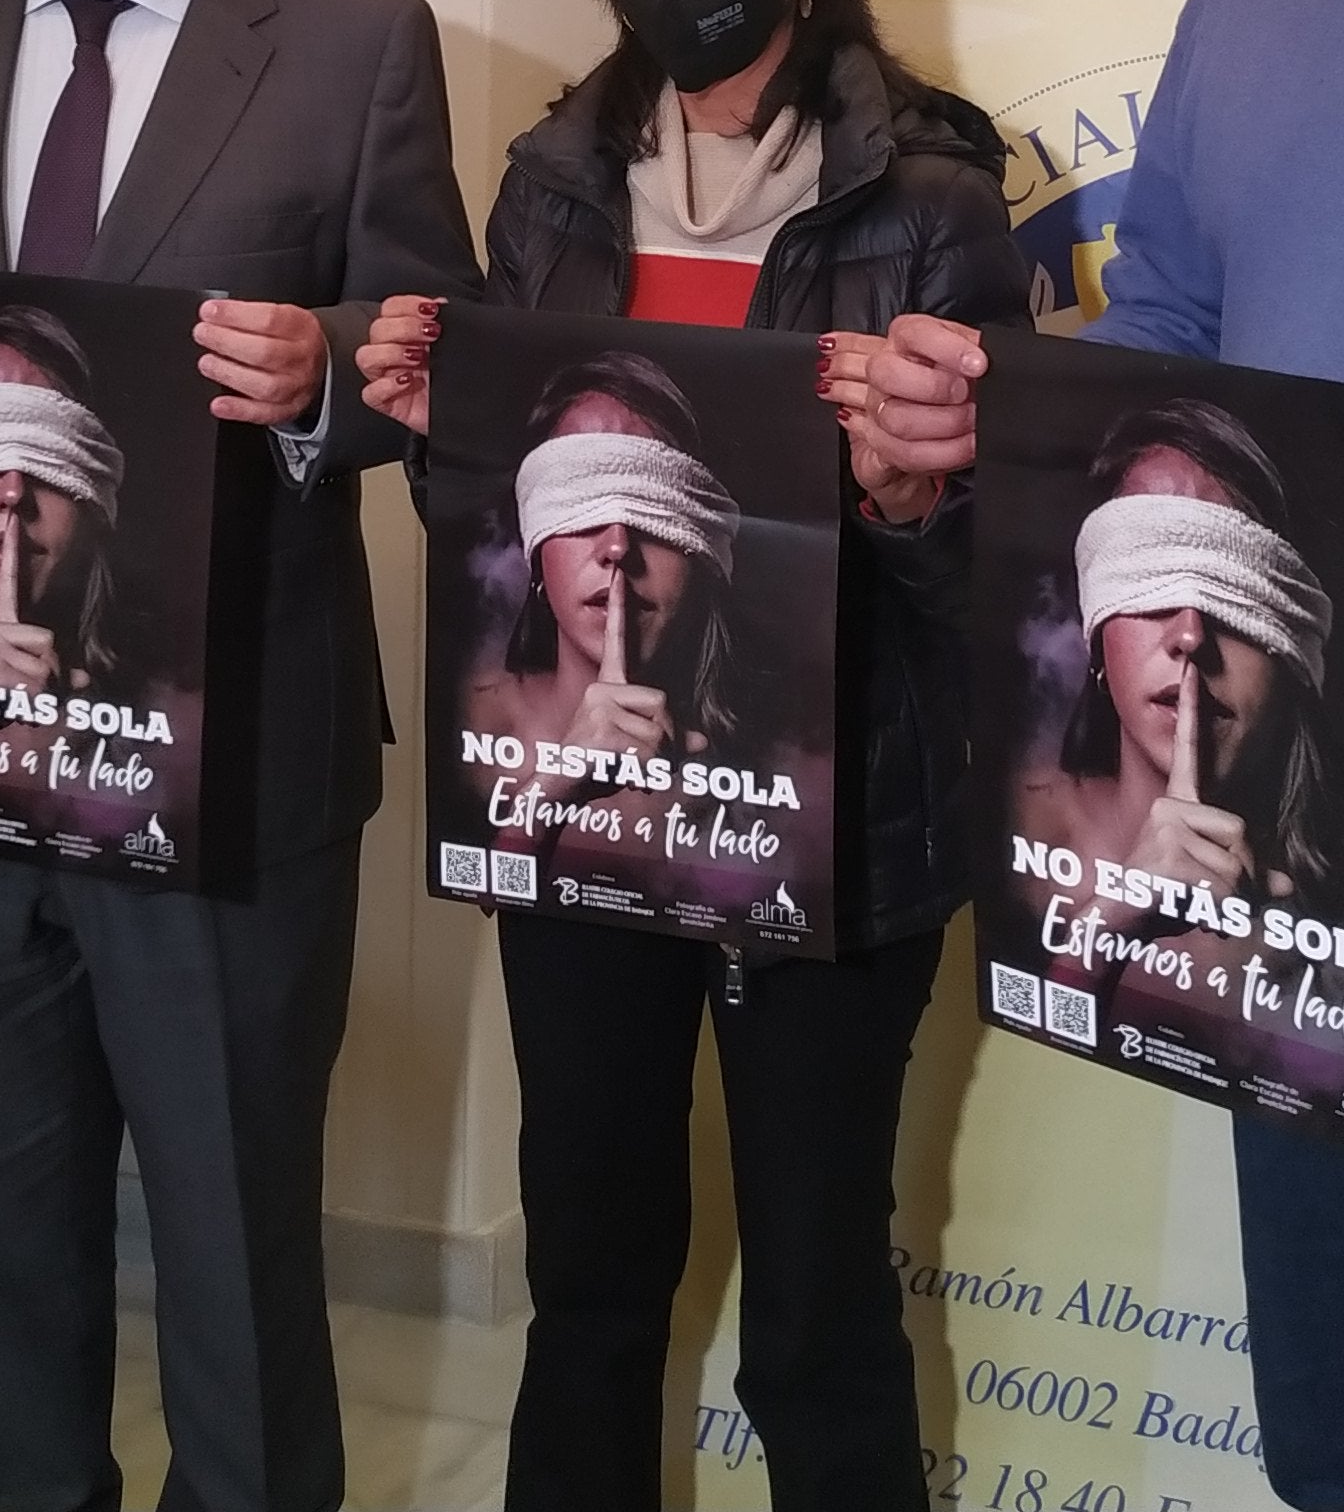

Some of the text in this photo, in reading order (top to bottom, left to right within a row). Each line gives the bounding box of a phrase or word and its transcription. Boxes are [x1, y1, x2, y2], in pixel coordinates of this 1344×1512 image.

[66, 699, 174, 745] SOLA
[21, 750, 39, 775] a
[49, 736, 82, 790] tu
[88, 738, 154, 796] lado
[461, 731, 801, 810] NO ESTÁS SOLA
[124, 829, 175, 857] alma
[488, 776, 780, 864] Estamos a tu lado
[750, 897, 807, 926] alma
[1012, 835, 1082, 887] NO
[1094, 858, 1252, 938] ESTÁS
[1041, 893, 1192, 990] Estamos
[1207, 965, 1229, 997] a
[1242, 953, 1283, 1021] tu
[1056, 1279, 1251, 1354] Albarrá
[966, 1359, 1267, 1474] 06002 Bada
[695, 1405, 764, 1470] Tlf.
[985, 1464, 1048, 1512] 18
[1061, 1480, 1126, 1512] 40
